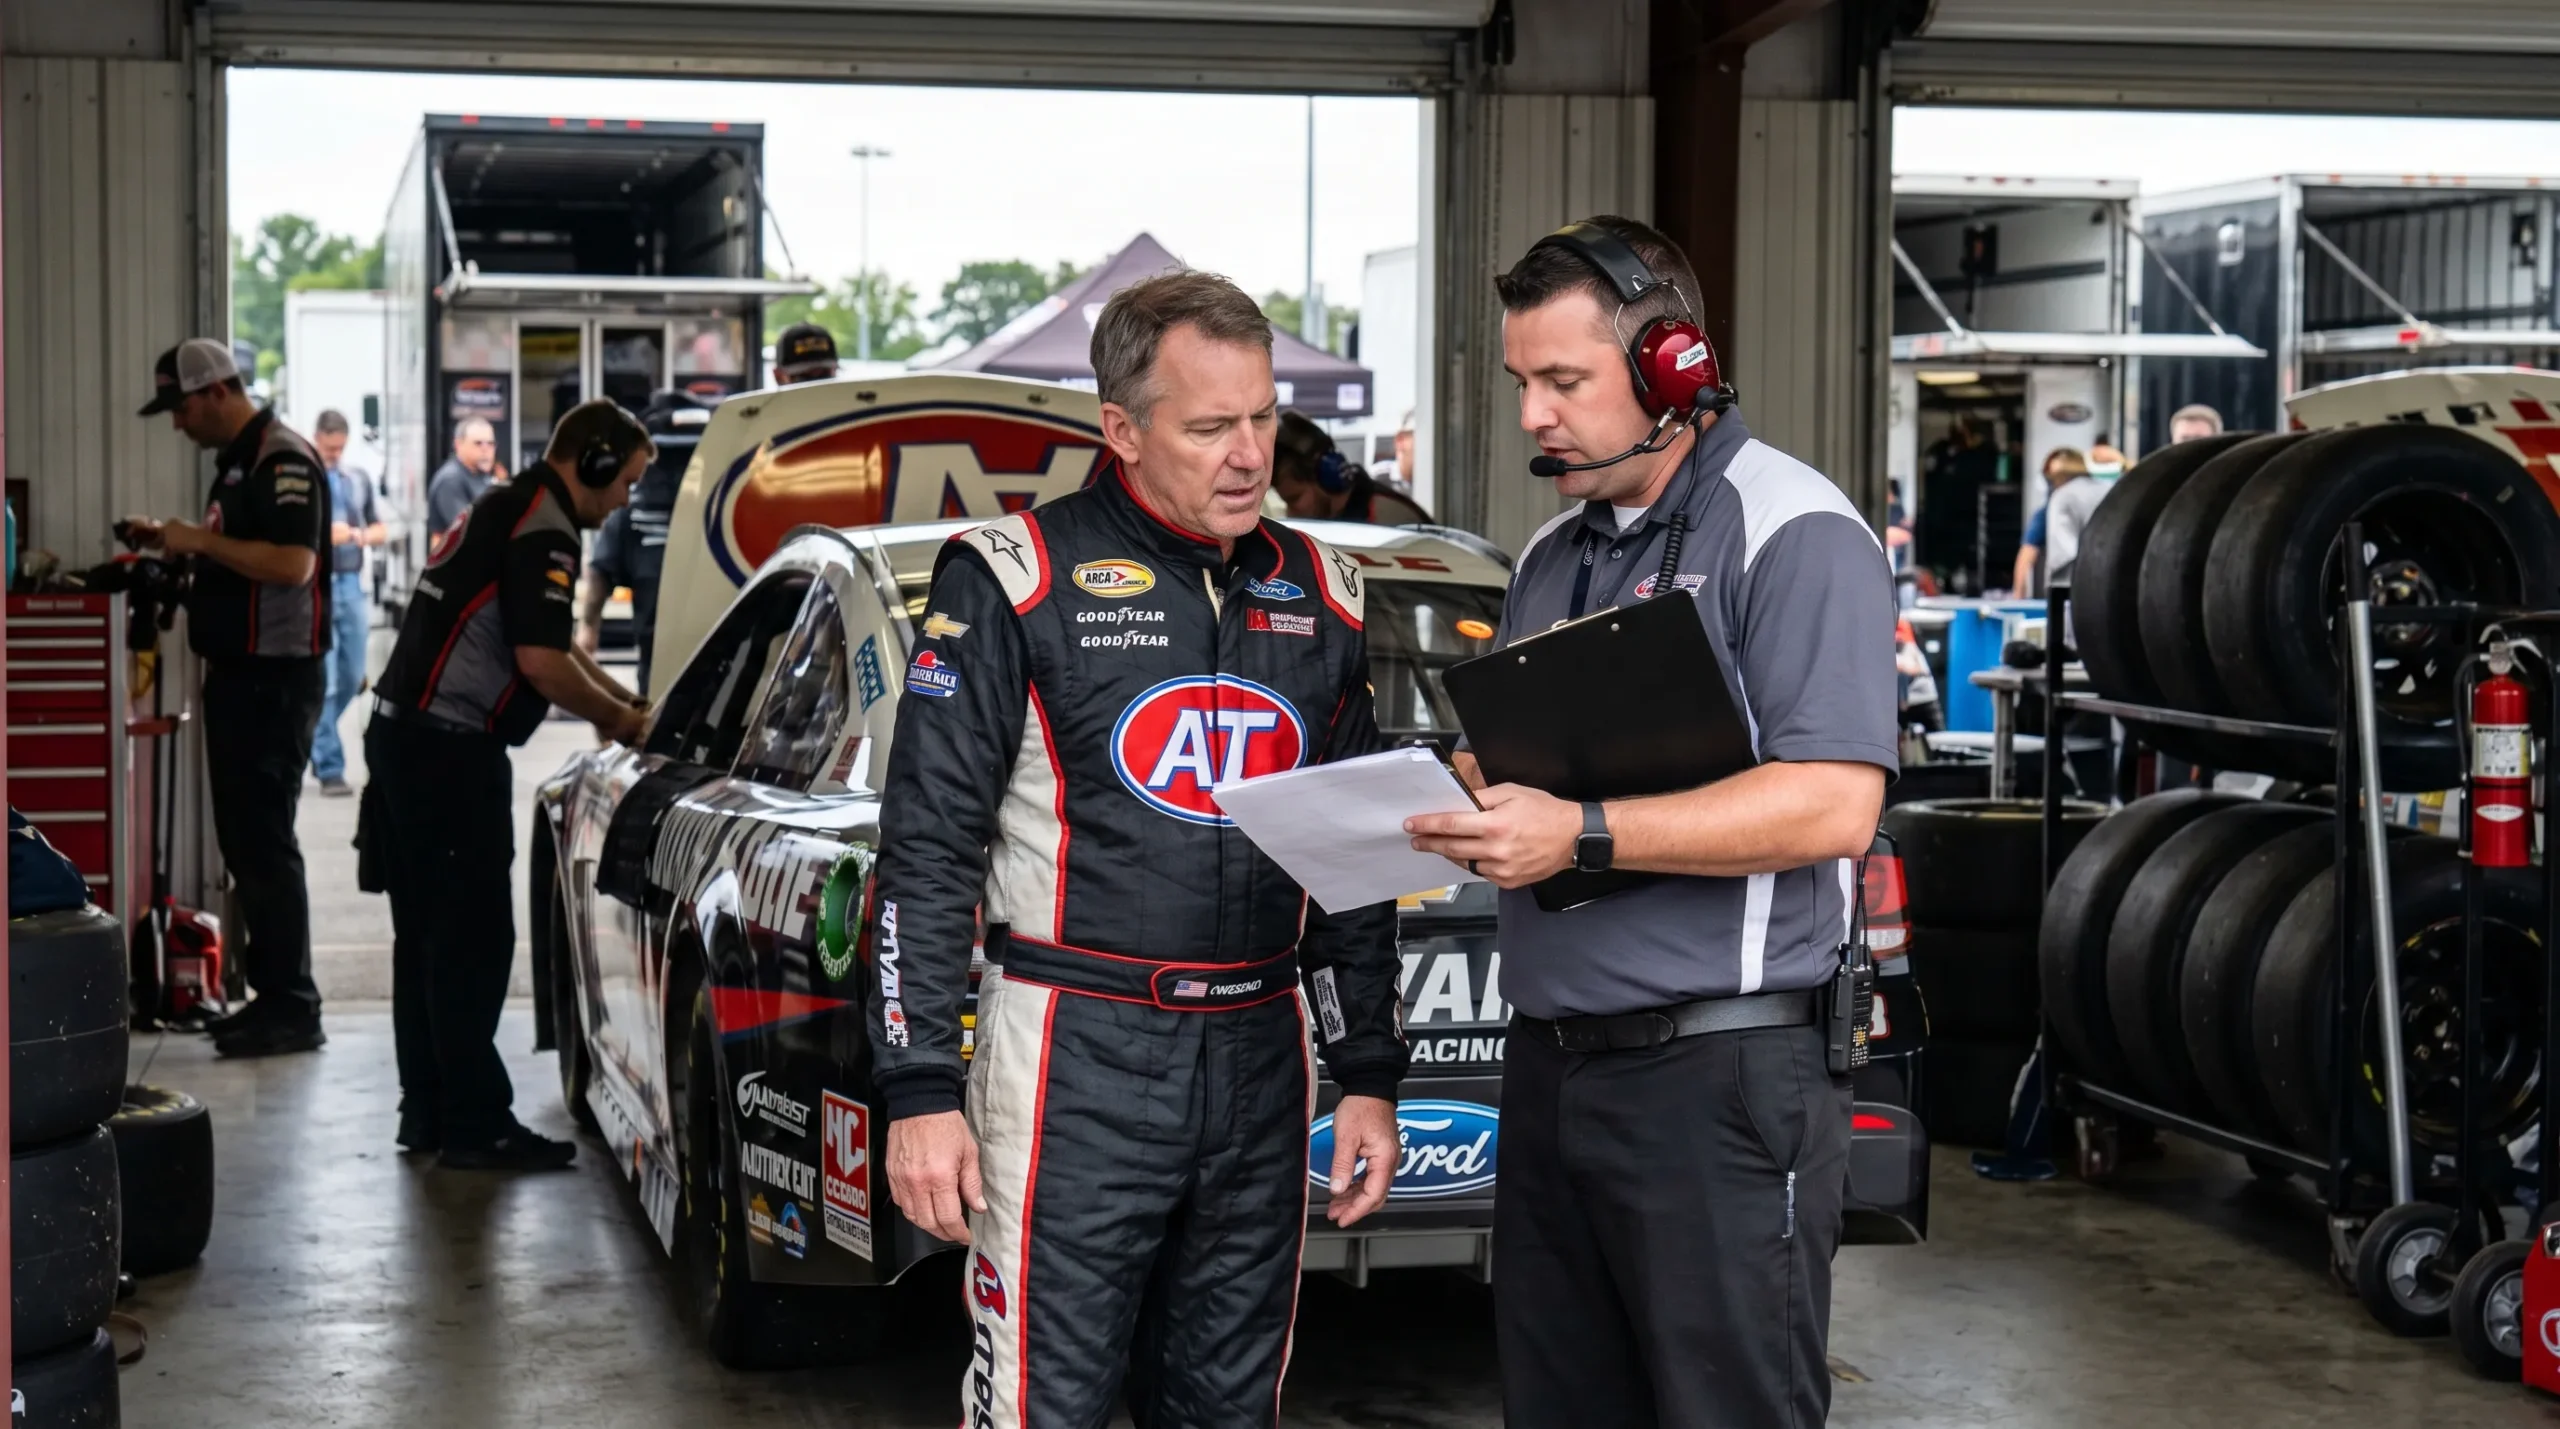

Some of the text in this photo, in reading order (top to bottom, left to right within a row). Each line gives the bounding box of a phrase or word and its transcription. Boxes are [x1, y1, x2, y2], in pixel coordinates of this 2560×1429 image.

[1085, 571, 1112, 584] ARCA
[1076, 608, 1166, 624] GOODYEAR
[1081, 631, 1170, 648] GOODYEAR
[1144, 708, 1281, 790] AT
[1405, 1037, 1506, 1063] ACIN
